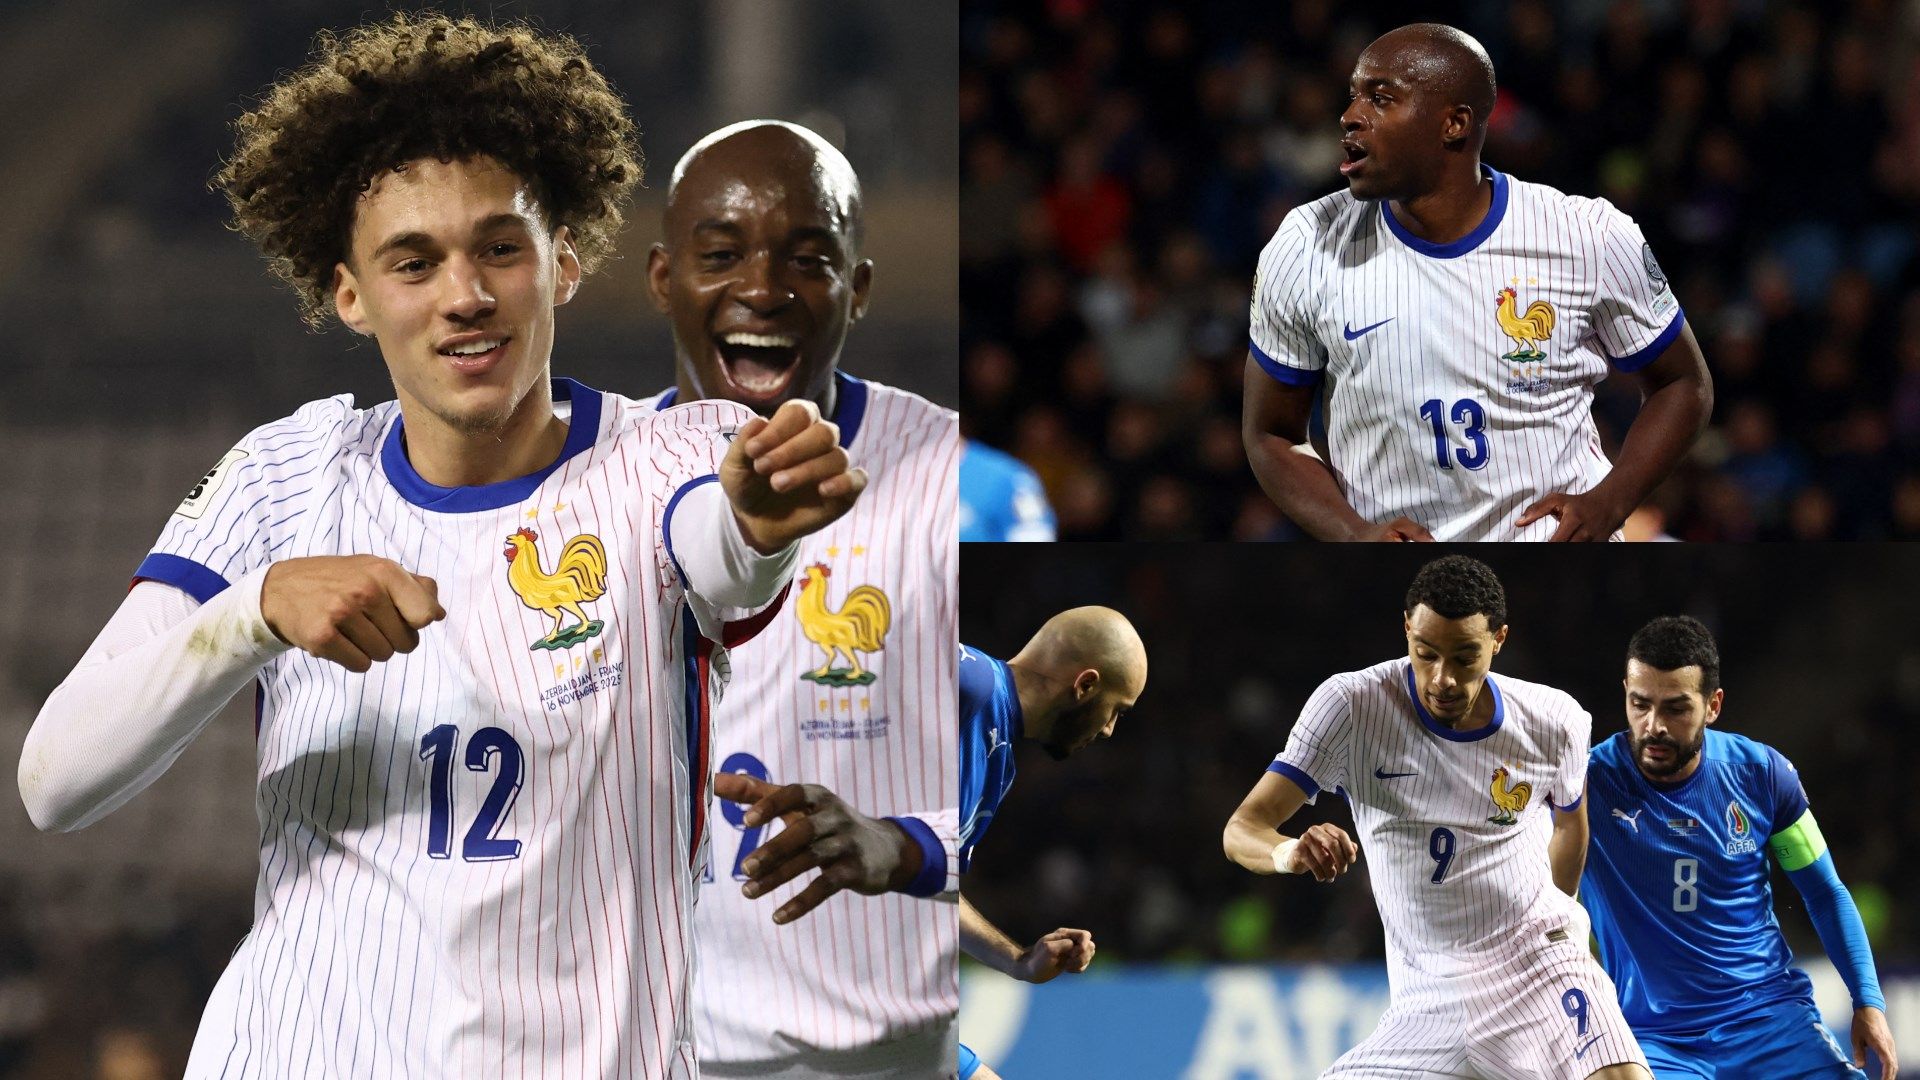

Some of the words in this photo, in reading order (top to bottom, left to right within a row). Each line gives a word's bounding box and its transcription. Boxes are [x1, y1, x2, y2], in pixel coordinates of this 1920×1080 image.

[1420, 398, 1490, 471] 13
[540, 671, 592, 702] AZERBAIDJAN
[598, 661, 624, 678] FRANC
[546, 701, 556, 711] 16
[558, 681, 599, 705] NOVEMBRE
[600, 675, 621, 690] 2025
[419, 724, 525, 862] 12
[1429, 827, 1456, 884] 9
[1727, 839, 1757, 855] AFFA
[1673, 858, 1699, 912] 8
[1561, 987, 1590, 1037] 9
